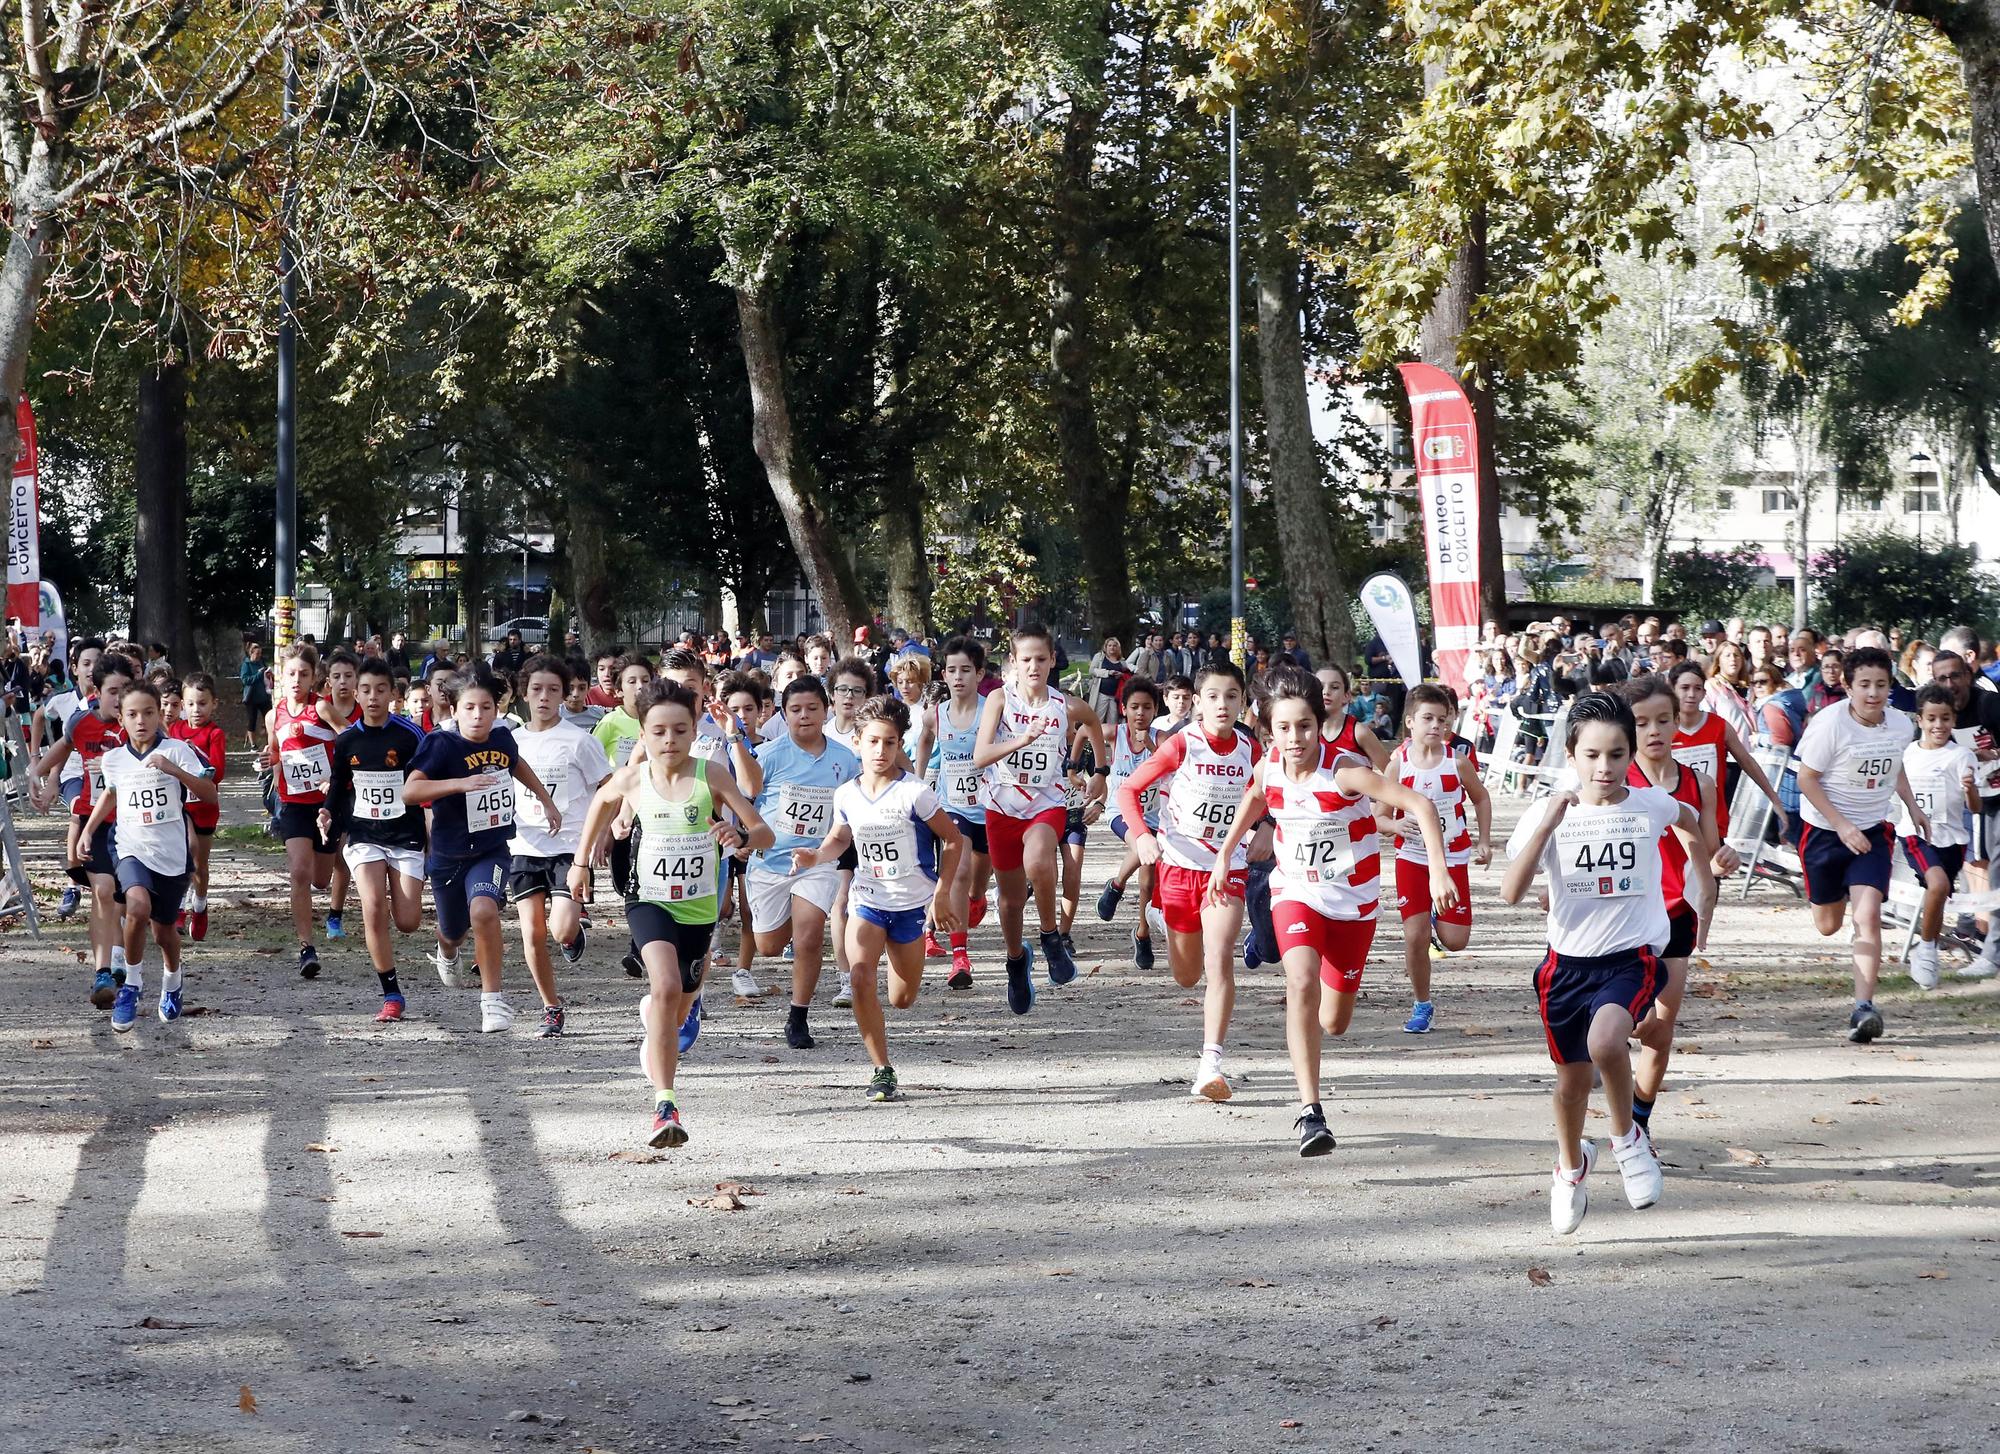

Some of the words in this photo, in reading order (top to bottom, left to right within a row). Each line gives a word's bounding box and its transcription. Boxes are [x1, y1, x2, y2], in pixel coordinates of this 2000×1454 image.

[464, 751, 510, 770] NYPD
[1007, 751, 1048, 771] 469
[1858, 759, 1892, 776] 450
[292, 761, 323, 780] 454
[1195, 764, 1244, 778] TREGA
[129, 788, 168, 809] 485
[362, 788, 394, 805] 459
[477, 789, 512, 813] 465
[524, 784, 557, 800] 47
[1140, 788, 1158, 804] 87
[1915, 793, 1933, 809] 51
[785, 802, 824, 823] 424
[1193, 802, 1236, 825] 468
[1583, 819, 1606, 827] CROSS
[1606, 827, 1621, 835] SAN
[1622, 826, 1647, 834] MIGUEL
[683, 835, 708, 843] ESCOLAR
[862, 842, 899, 862] 436
[1295, 840, 1337, 866] 472
[1575, 842, 1636, 873] 449
[653, 856, 704, 881] 443
